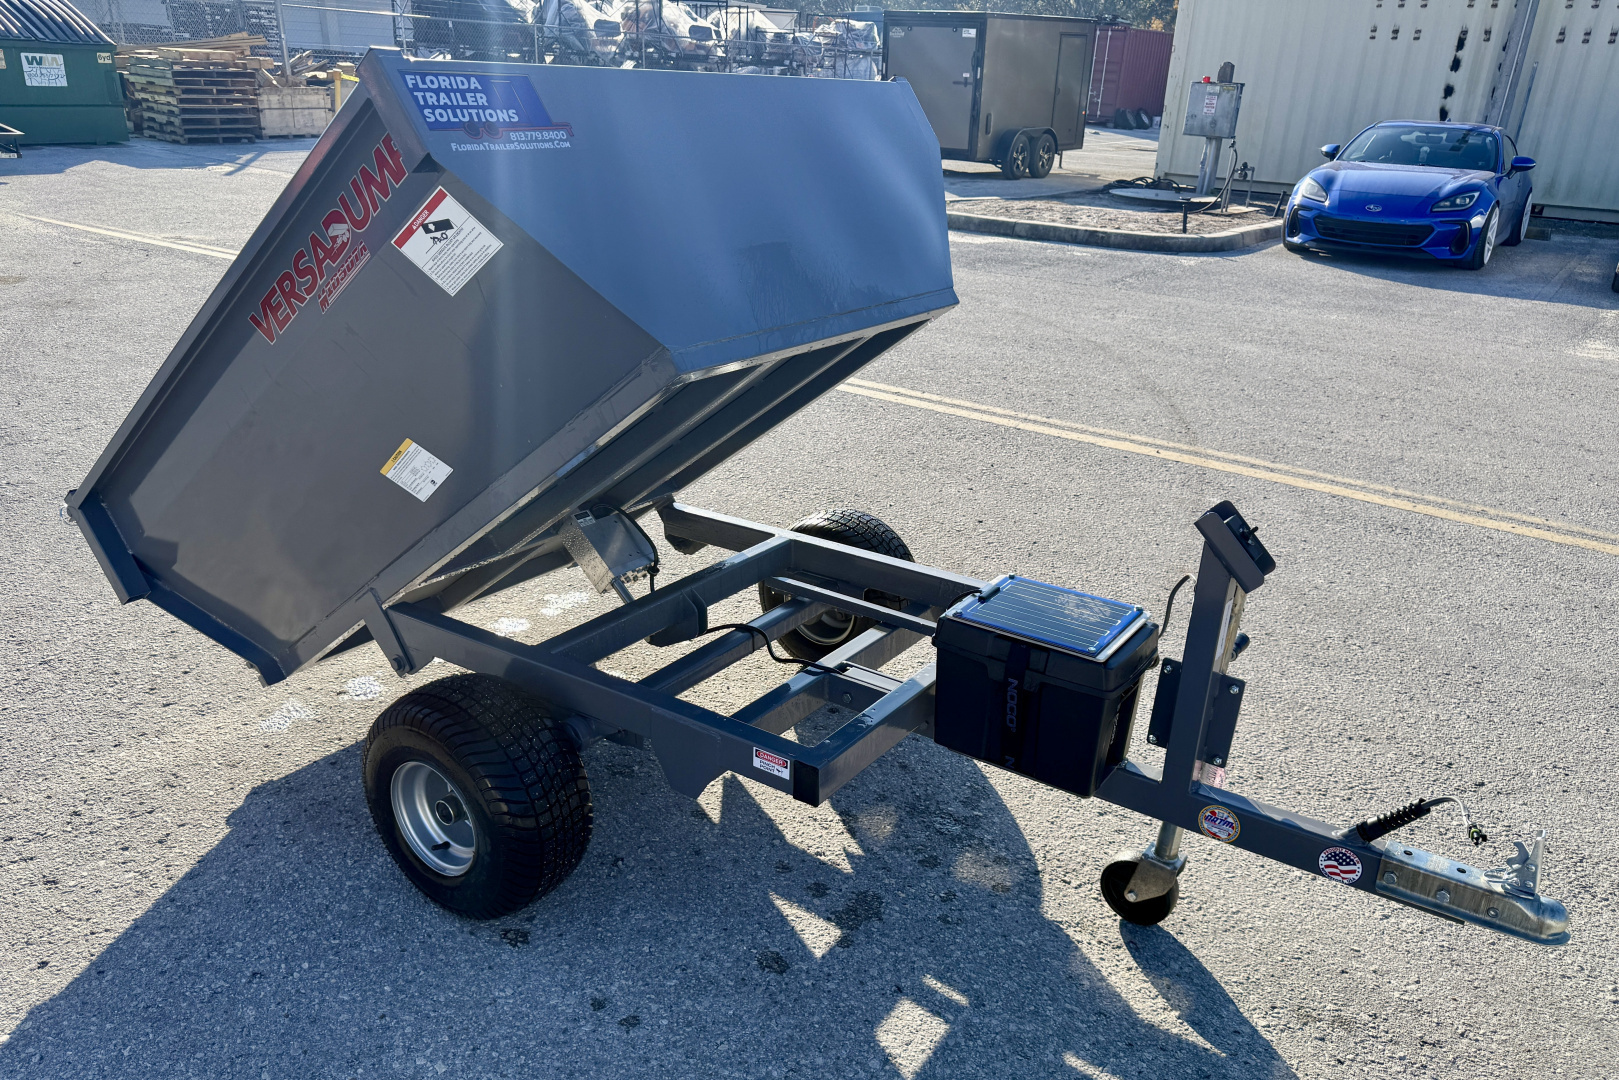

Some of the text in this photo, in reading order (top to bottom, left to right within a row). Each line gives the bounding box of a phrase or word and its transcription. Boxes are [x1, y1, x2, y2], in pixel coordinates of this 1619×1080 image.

[24, 55, 60, 66] WM
[404, 74, 482, 90] FLORIDA
[413, 91, 489, 106] TRAILER
[423, 108, 519, 122] SOLUTIONS
[510, 131, 567, 141] 813.779.8400
[413, 209, 430, 227] DANGER
[1006, 677, 1019, 729] NOCO
[759, 751, 784, 765] DANGER
